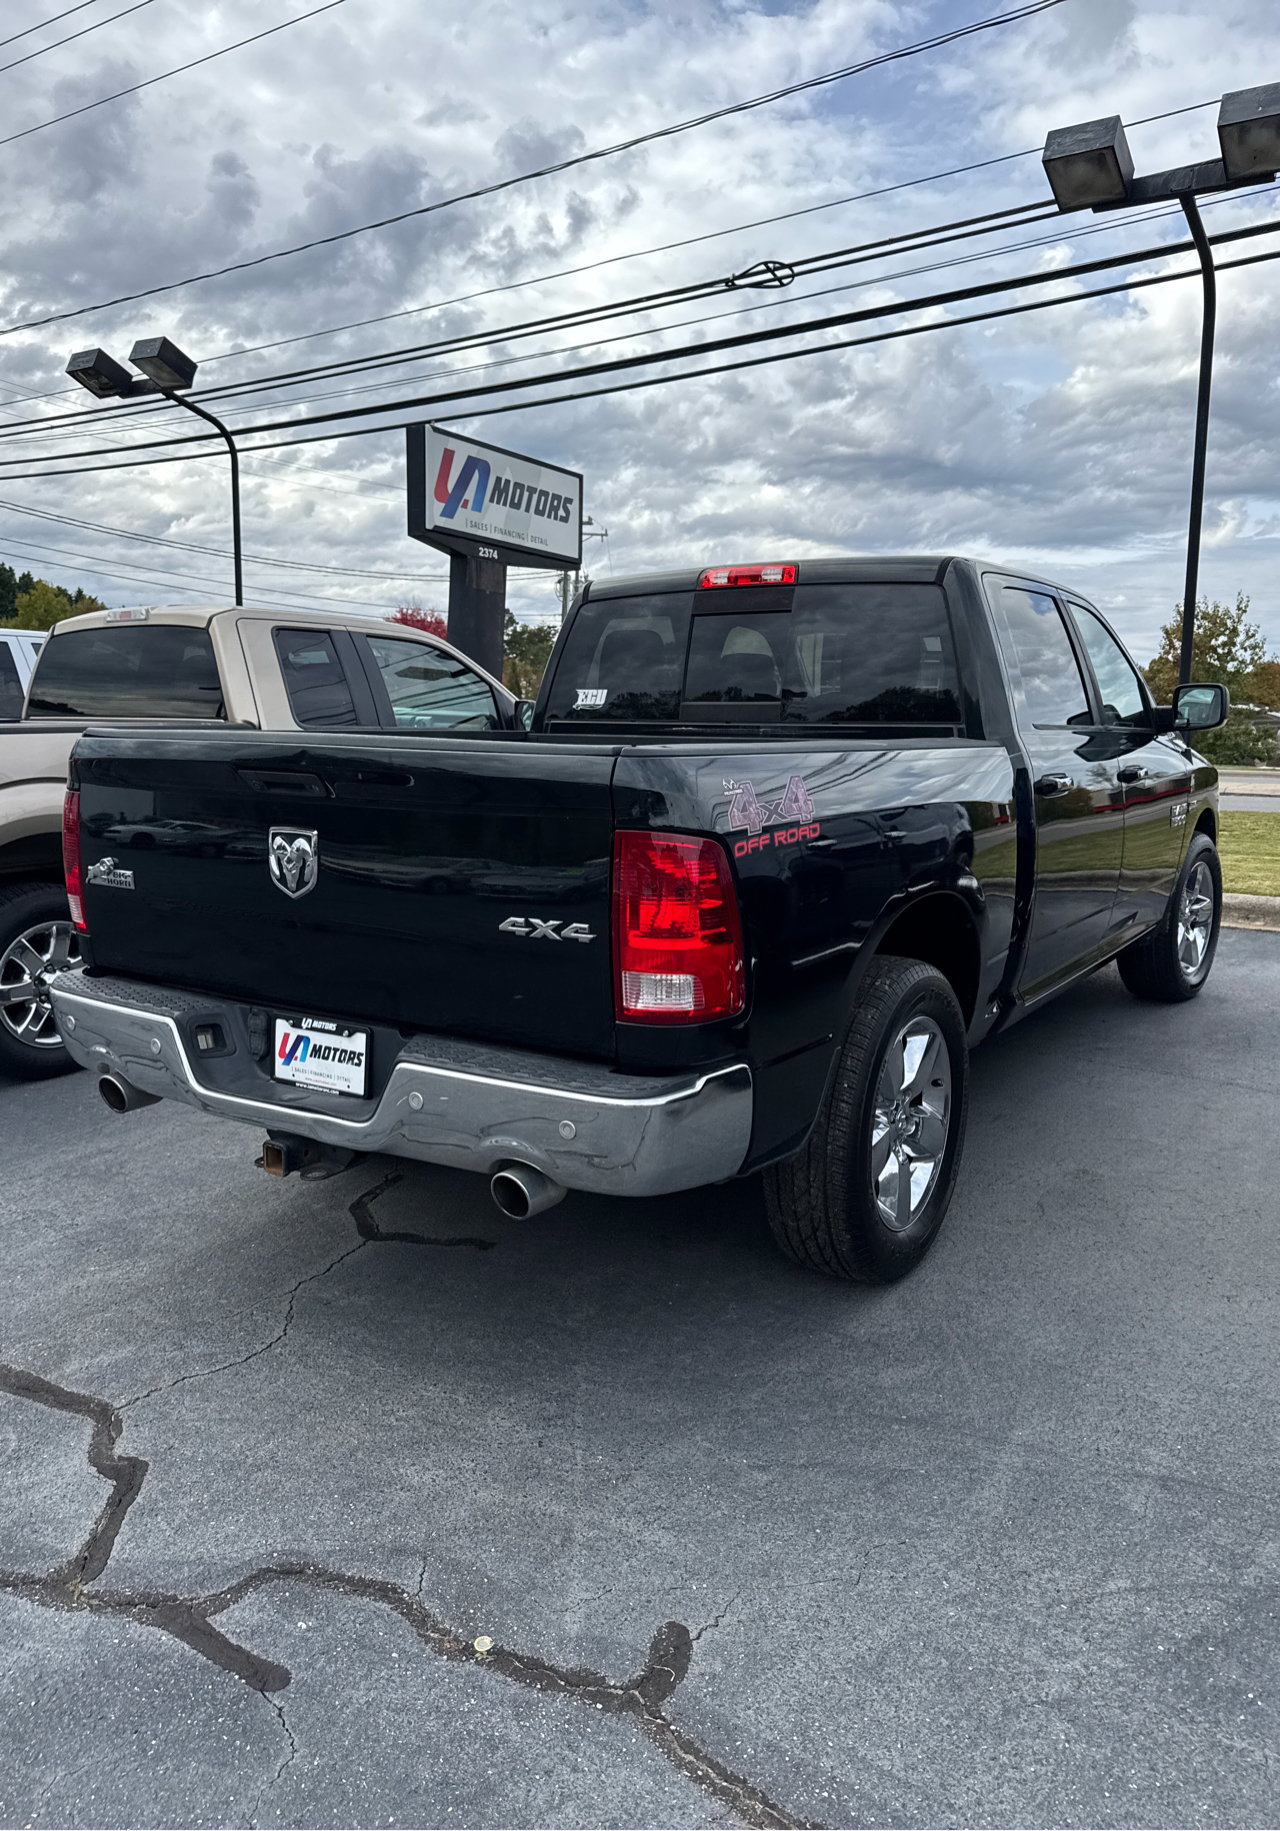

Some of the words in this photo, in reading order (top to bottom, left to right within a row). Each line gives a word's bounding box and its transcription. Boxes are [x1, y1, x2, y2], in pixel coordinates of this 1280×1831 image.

[489, 476, 574, 523] MOTORS
[469, 520, 488, 532] SALES
[494, 526, 525, 541] FINANCING
[530, 535, 549, 546] DETAIL
[478, 547, 499, 560] 2374
[734, 834, 770, 858] OFF
[774, 823, 820, 847] ROAD
[107, 878, 132, 887] HORN
[312, 1020, 337, 1031] MOTORS
[309, 1043, 364, 1067] MOTORS
[294, 1067, 307, 1075] SALES
[310, 1069, 333, 1079] FINANCING
